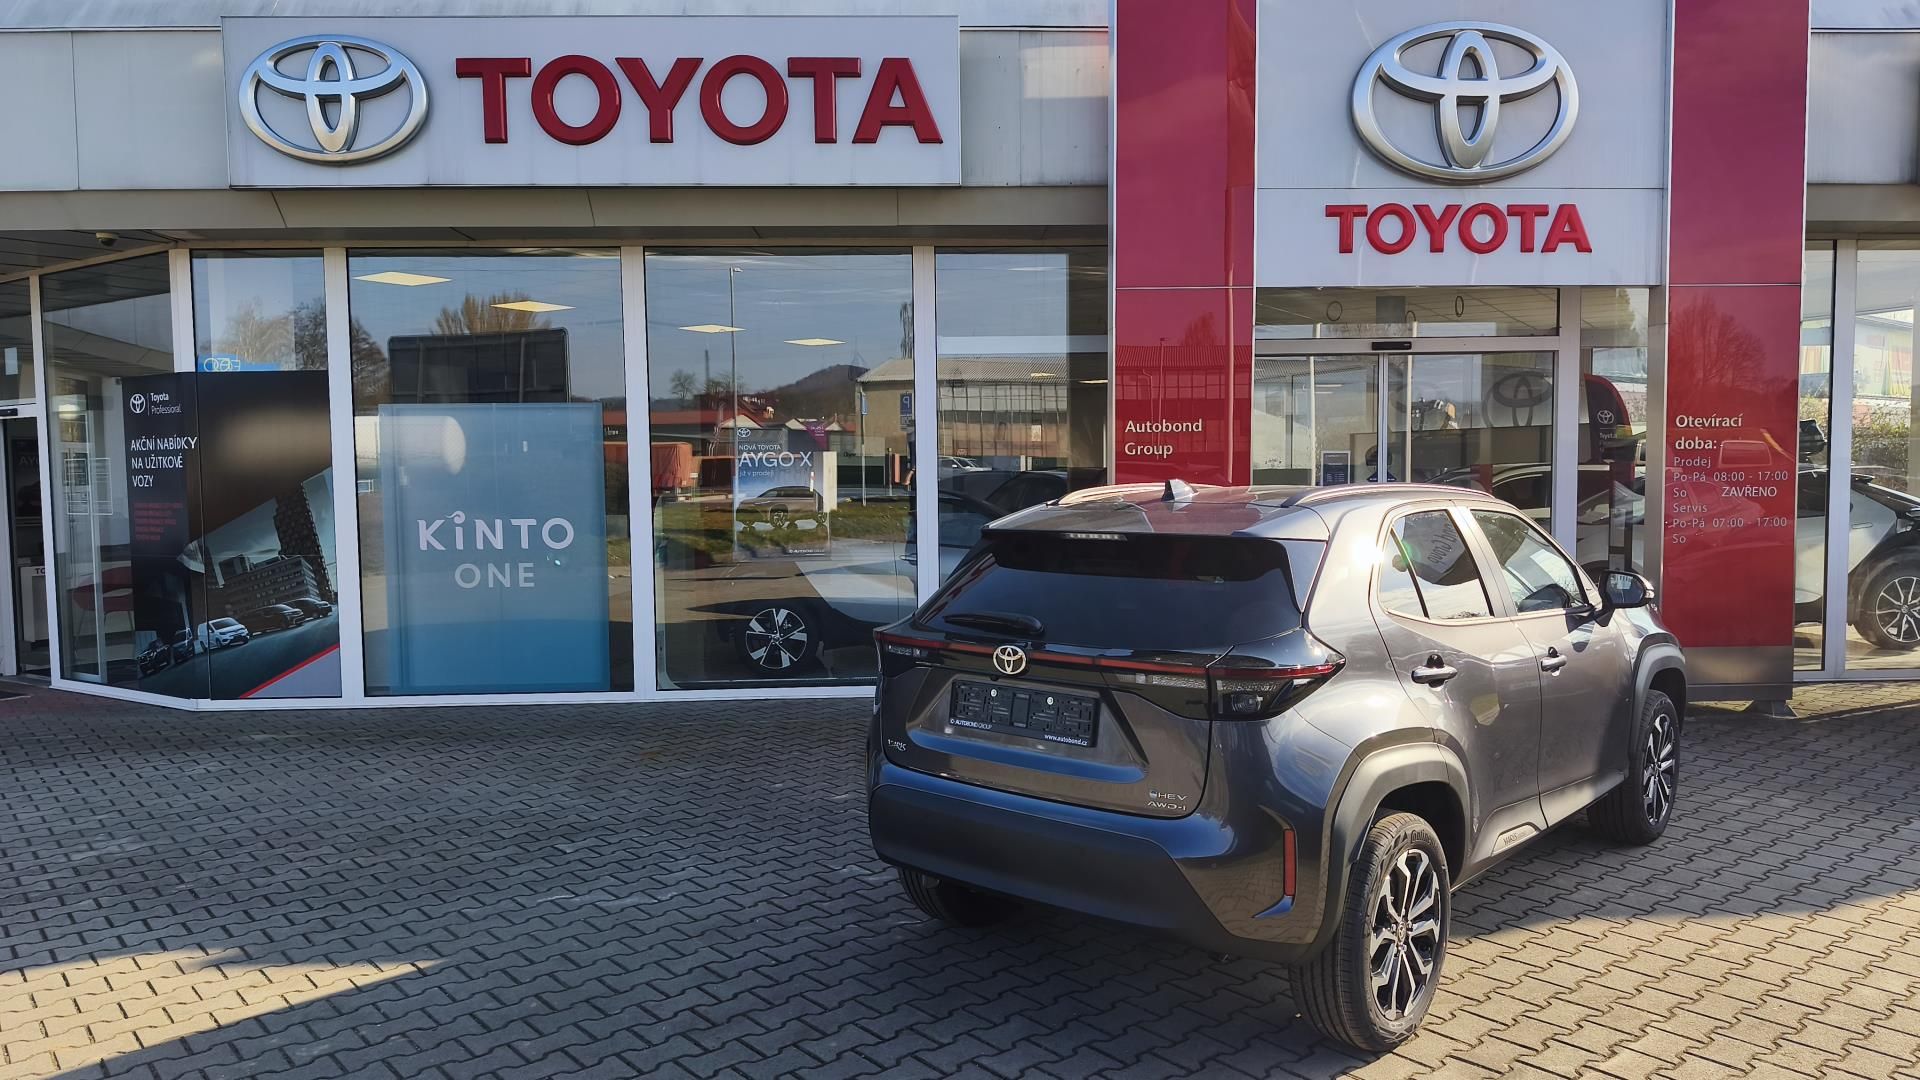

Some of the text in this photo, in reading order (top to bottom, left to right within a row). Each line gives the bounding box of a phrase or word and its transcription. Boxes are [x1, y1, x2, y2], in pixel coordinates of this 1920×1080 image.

[456, 54, 944, 146] TOYOTA
[1325, 202, 1592, 255] TOYOTA
[151, 392, 169, 403] Toyota
[151, 405, 181, 414] Professional
[1125, 418, 1202, 433] Autobond
[1675, 413, 1744, 428] Otevírací
[130, 434, 198, 451] AKČNÍ NABÍDKY
[739, 443, 757, 451] NOVÁ
[1675, 437, 1717, 450] doba:
[1124, 442, 1173, 459] Group
[131, 452, 183, 469] NA UŽITKOVÉ
[739, 451, 812, 468] AYGO X
[1674, 456, 1711, 469] Prodej
[132, 475, 154, 487] VOZY
[1673, 472, 1706, 482] Po-Pá
[1713, 471, 1745, 482] 08:00
[1758, 470, 1788, 481] 17:00
[1673, 485, 1777, 498] So ZAVŘENO
[1673, 502, 1708, 513] Servis
[1672, 518, 1705, 529] Po-Pá
[1712, 517, 1744, 528] 07:00
[1757, 517, 1788, 527] 17:00
[1672, 534, 1686, 544] So
[454, 562, 535, 589] ONE
[1044, 733, 1088, 747] www.autobond.cz
[1158, 792, 1188, 801] HEV
